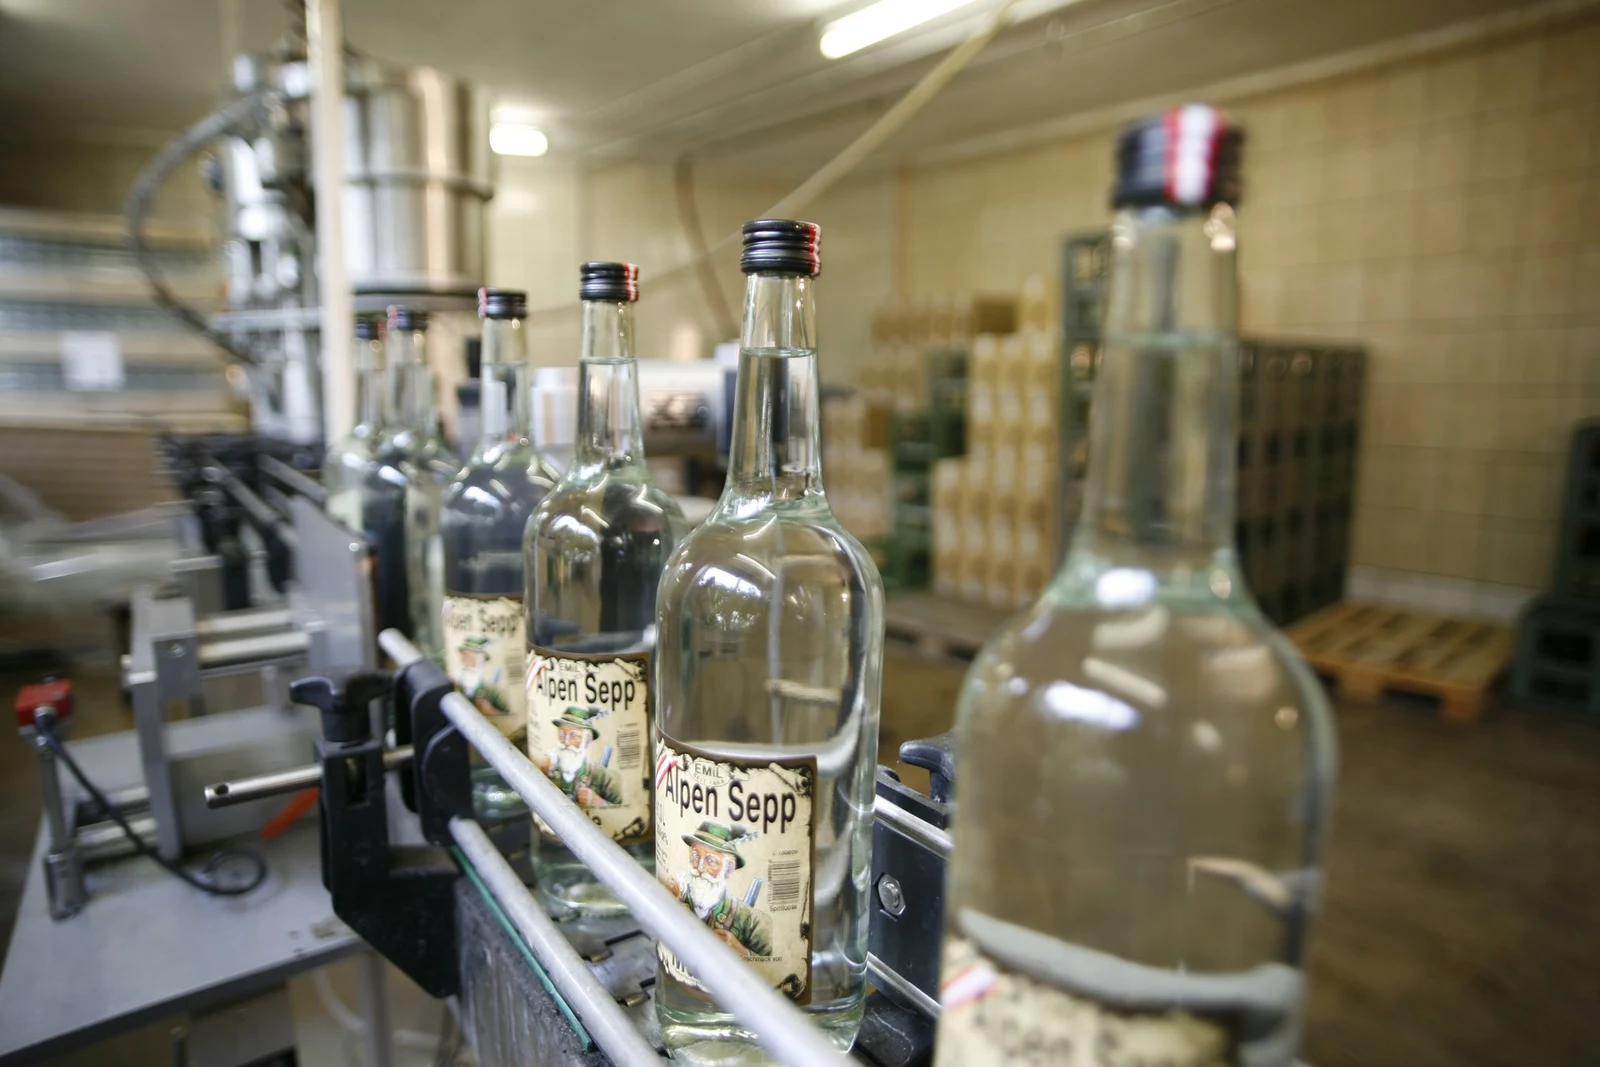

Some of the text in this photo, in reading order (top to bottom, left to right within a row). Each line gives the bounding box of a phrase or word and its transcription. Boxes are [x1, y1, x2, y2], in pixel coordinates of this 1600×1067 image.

[479, 608, 518, 637] Sepp
[536, 672, 636, 711] Alpen Sepp
[665, 764, 719, 818] Alpen
[728, 779, 797, 834] Sepp
